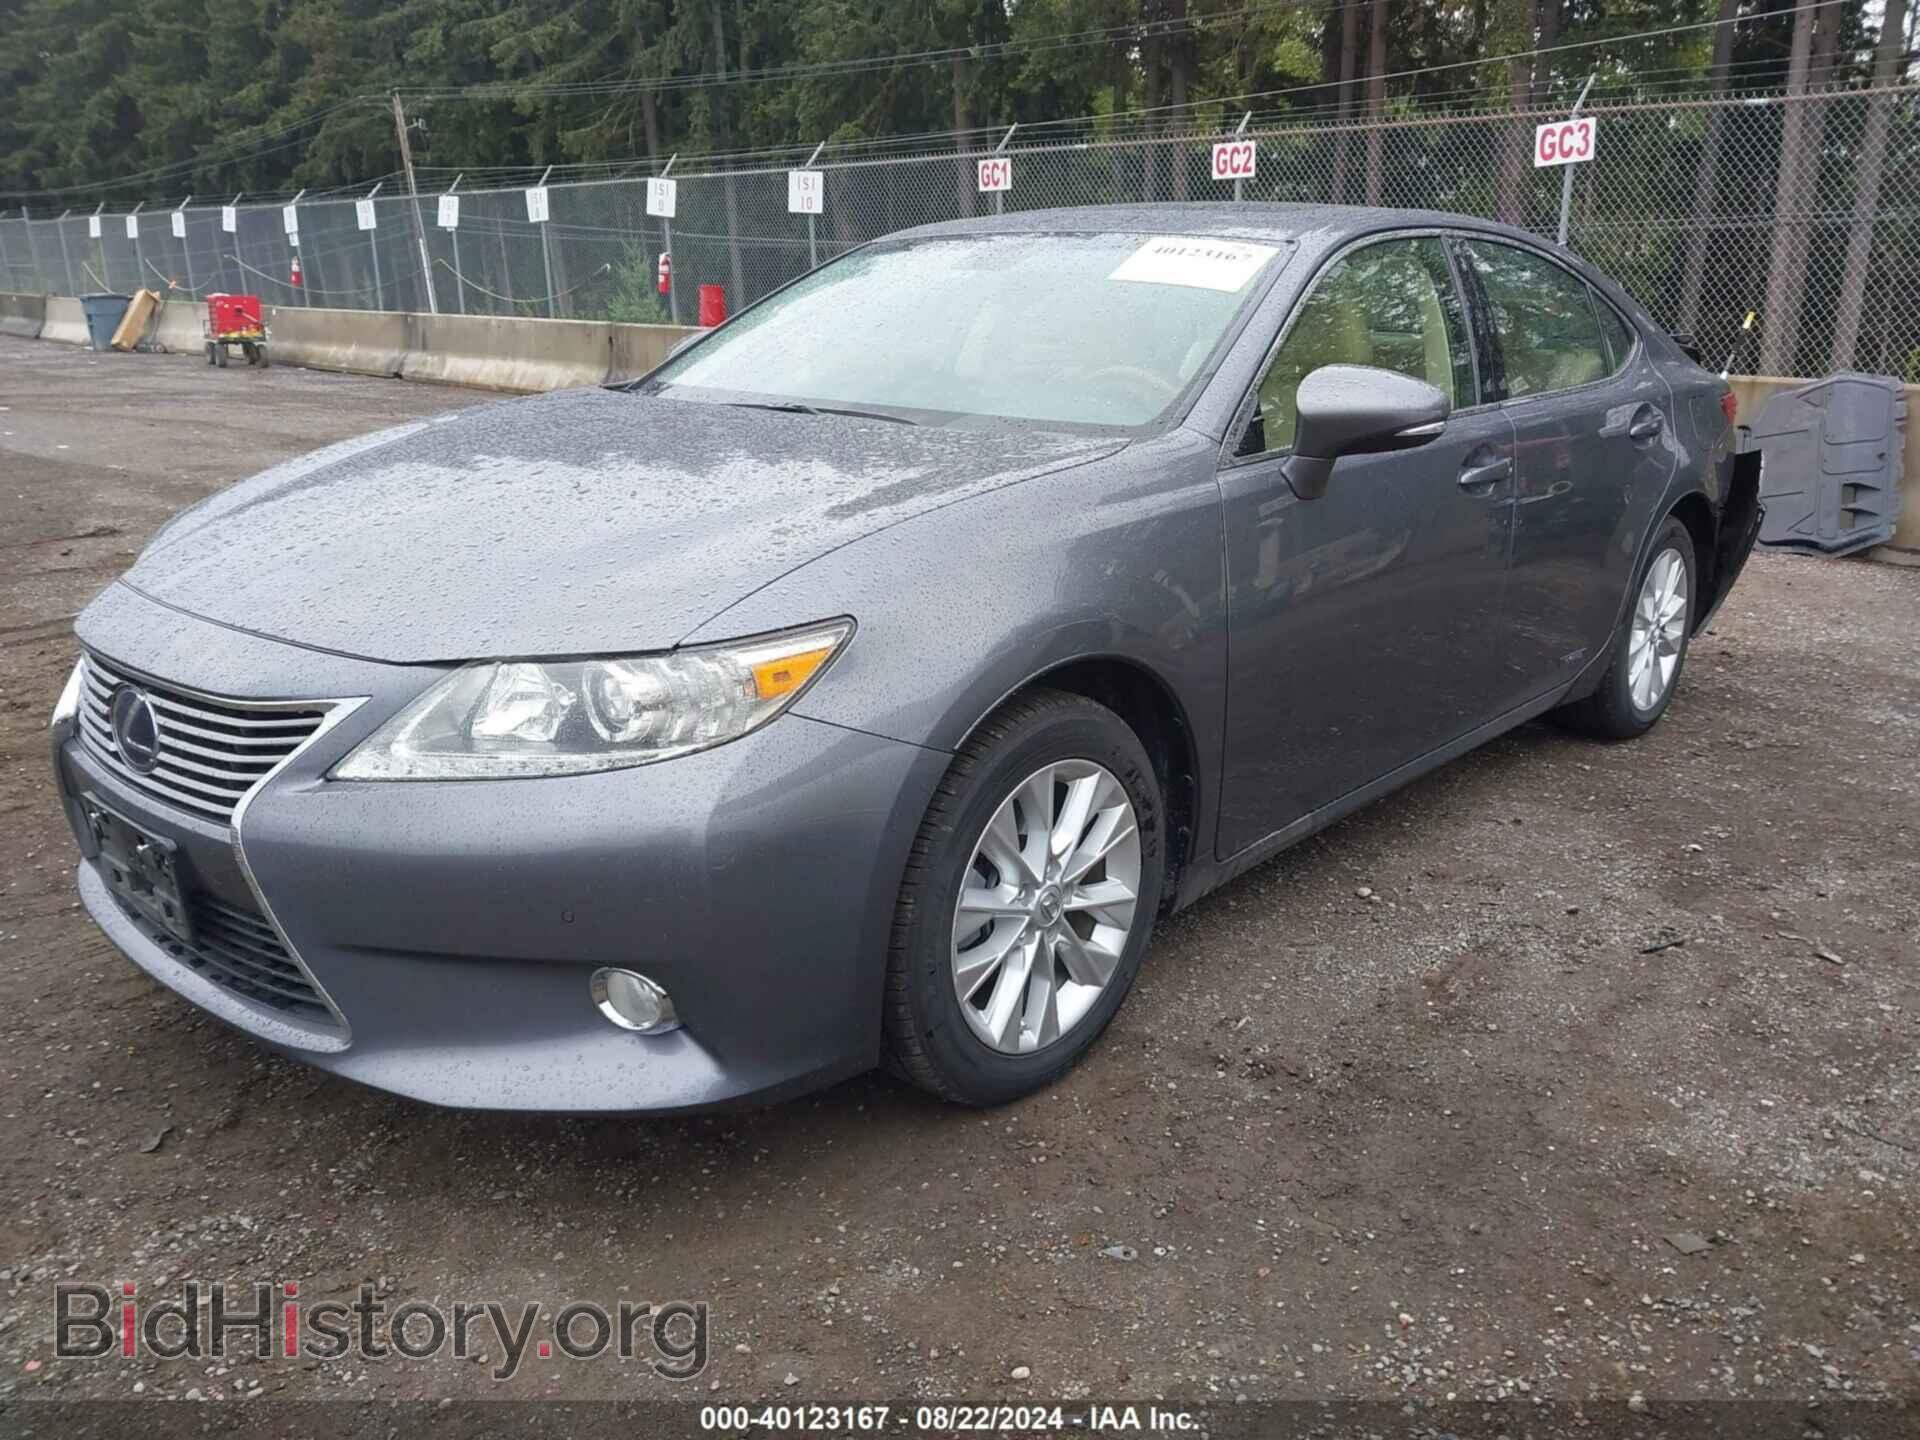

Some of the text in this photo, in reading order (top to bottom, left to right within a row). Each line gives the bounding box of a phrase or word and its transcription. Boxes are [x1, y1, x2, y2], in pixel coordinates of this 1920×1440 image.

[1540, 123, 1590, 161] GC3
[981, 162, 1007, 187] GC1
[1216, 145, 1252, 175] GC2
